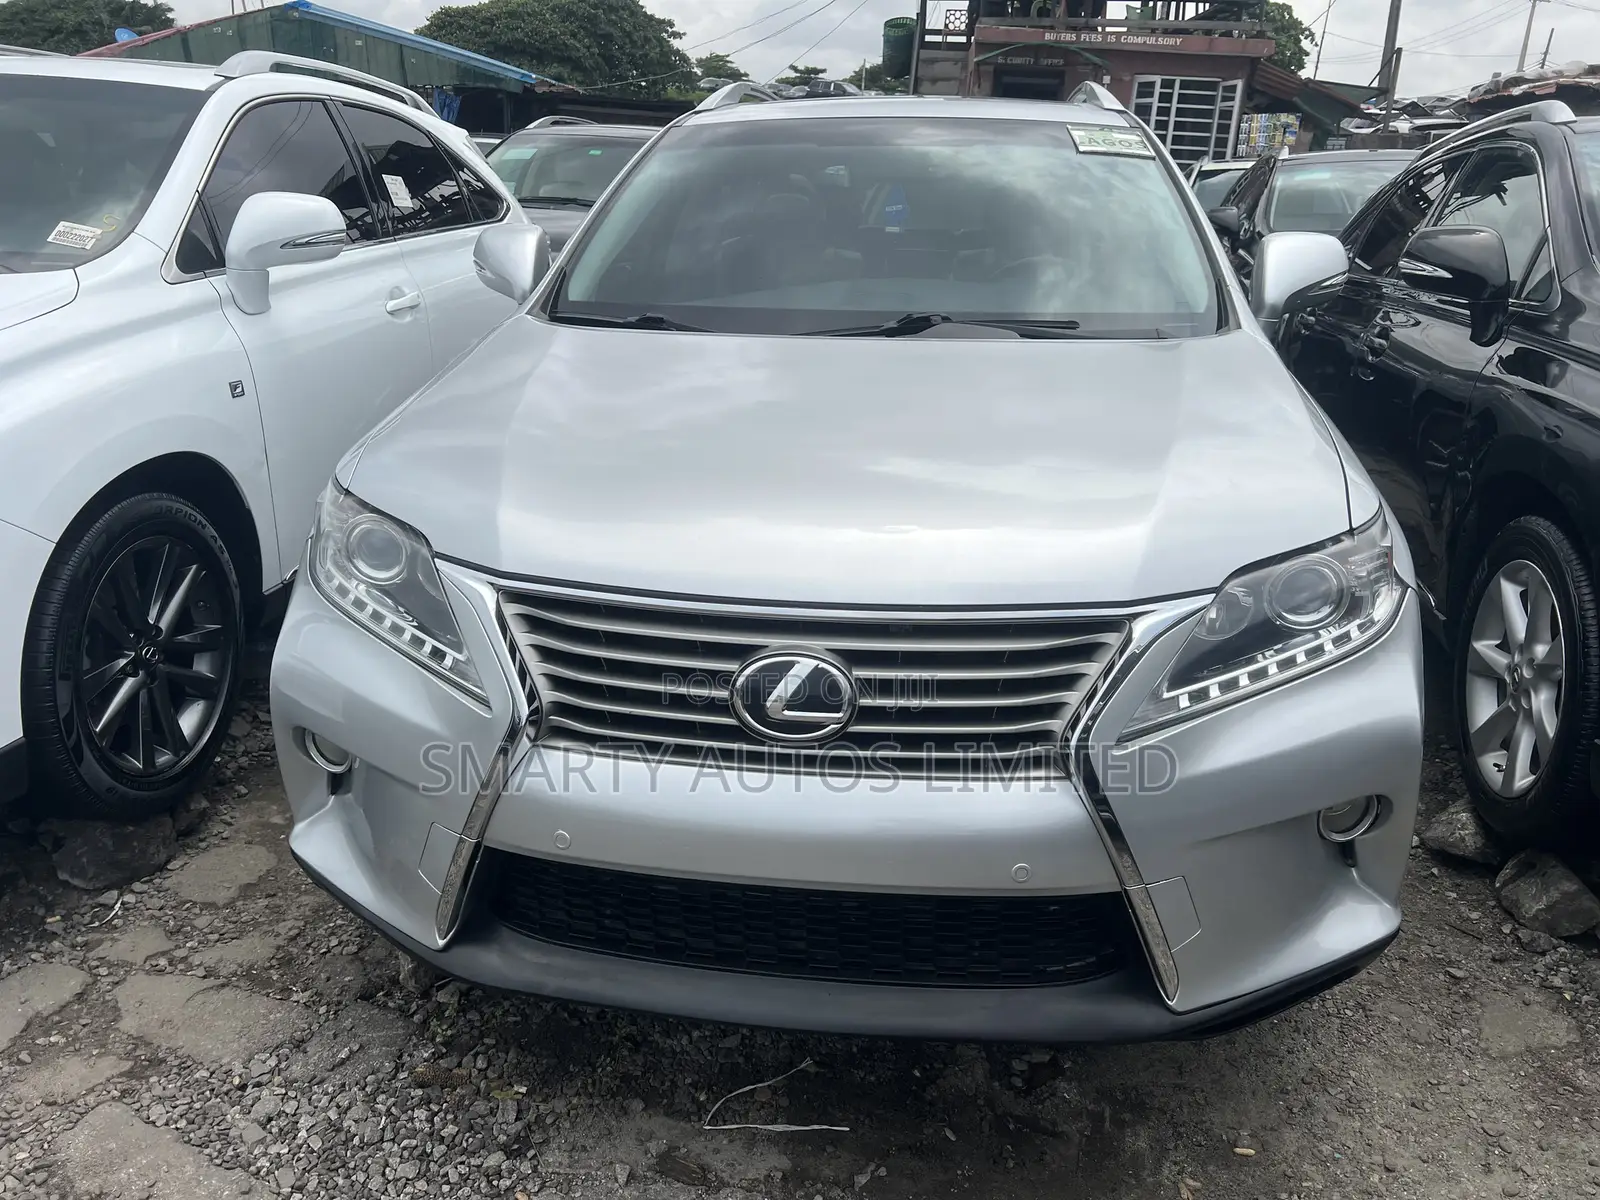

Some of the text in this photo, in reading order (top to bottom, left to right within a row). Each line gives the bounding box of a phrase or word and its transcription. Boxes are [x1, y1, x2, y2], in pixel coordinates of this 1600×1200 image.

[1044, 32, 1184, 46] BUYERS FEES IS COMPULSORY
[54, 229, 93, 244] 000222027
